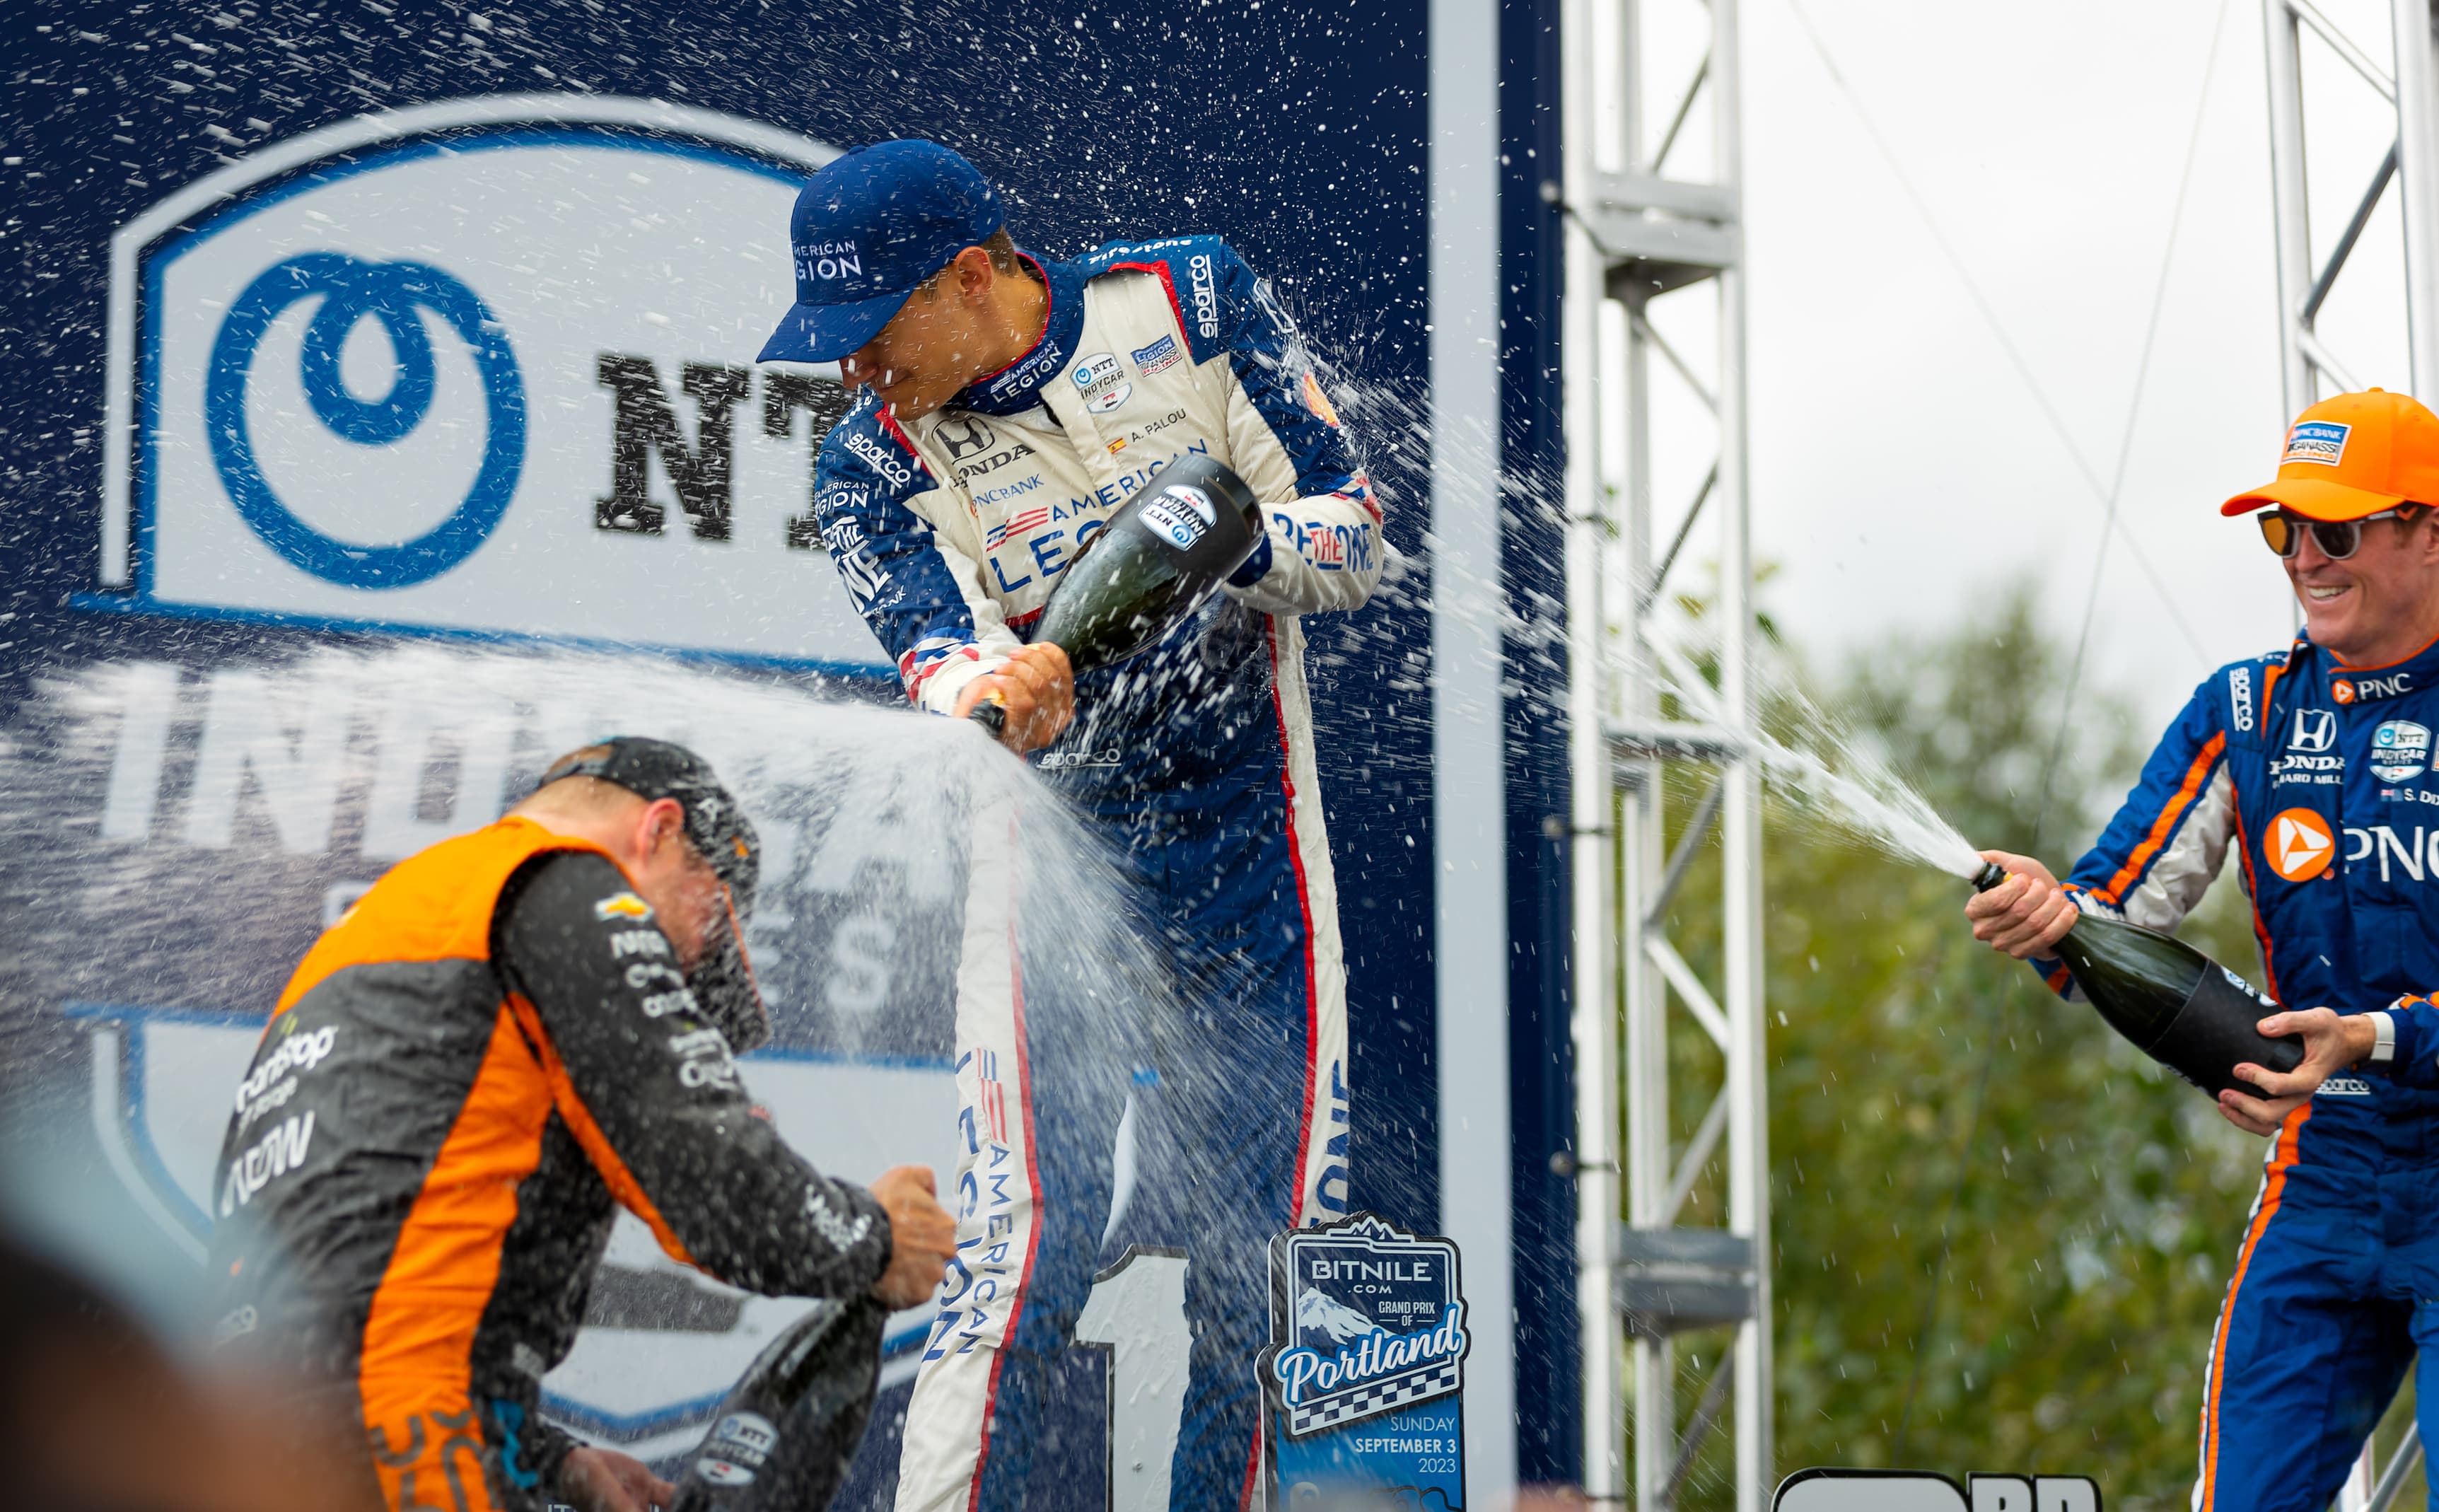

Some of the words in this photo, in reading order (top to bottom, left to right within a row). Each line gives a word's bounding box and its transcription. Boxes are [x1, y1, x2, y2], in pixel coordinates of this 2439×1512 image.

[793, 240, 856, 257] MERICAN
[795, 255, 862, 281] GION
[1189, 254, 1218, 339] sparco
[1010, 339, 1056, 380] AMERICAN
[1091, 358, 1114, 375] NTT
[992, 346, 1063, 403] LEGION
[1081, 371, 1124, 400] INDYCAR
[1131, 431, 1144, 443] A.
[1145, 408, 1187, 436] PALOU
[596, 352, 843, 550] NT
[844, 433, 912, 489] sparco
[1310, 530, 1344, 562] THE
[2229, 666, 2254, 732] sparco
[2357, 673, 2414, 702] PNC
[2397, 733, 2424, 743] NTT
[1037, 748, 1122, 769] sparco
[2371, 749, 2427, 760] INDYCAR
[956, 1144, 1013, 1354] AMERICAN
[1311, 1260, 1433, 1282] BITNILE
[1347, 1284, 1392, 1295] .COM
[1378, 1301, 1411, 1314] GRAND
[1413, 1301, 1436, 1315] PRIX
[1401, 1314, 1414, 1327] OF
[1281, 1307, 1461, 1403] Portland
[1390, 1416, 1456, 1432] SUNDAY
[1355, 1438, 1440, 1454] SEPTEMBER
[1446, 1438, 1457, 1454] 3
[1419, 1458, 1457, 1474] 2023
